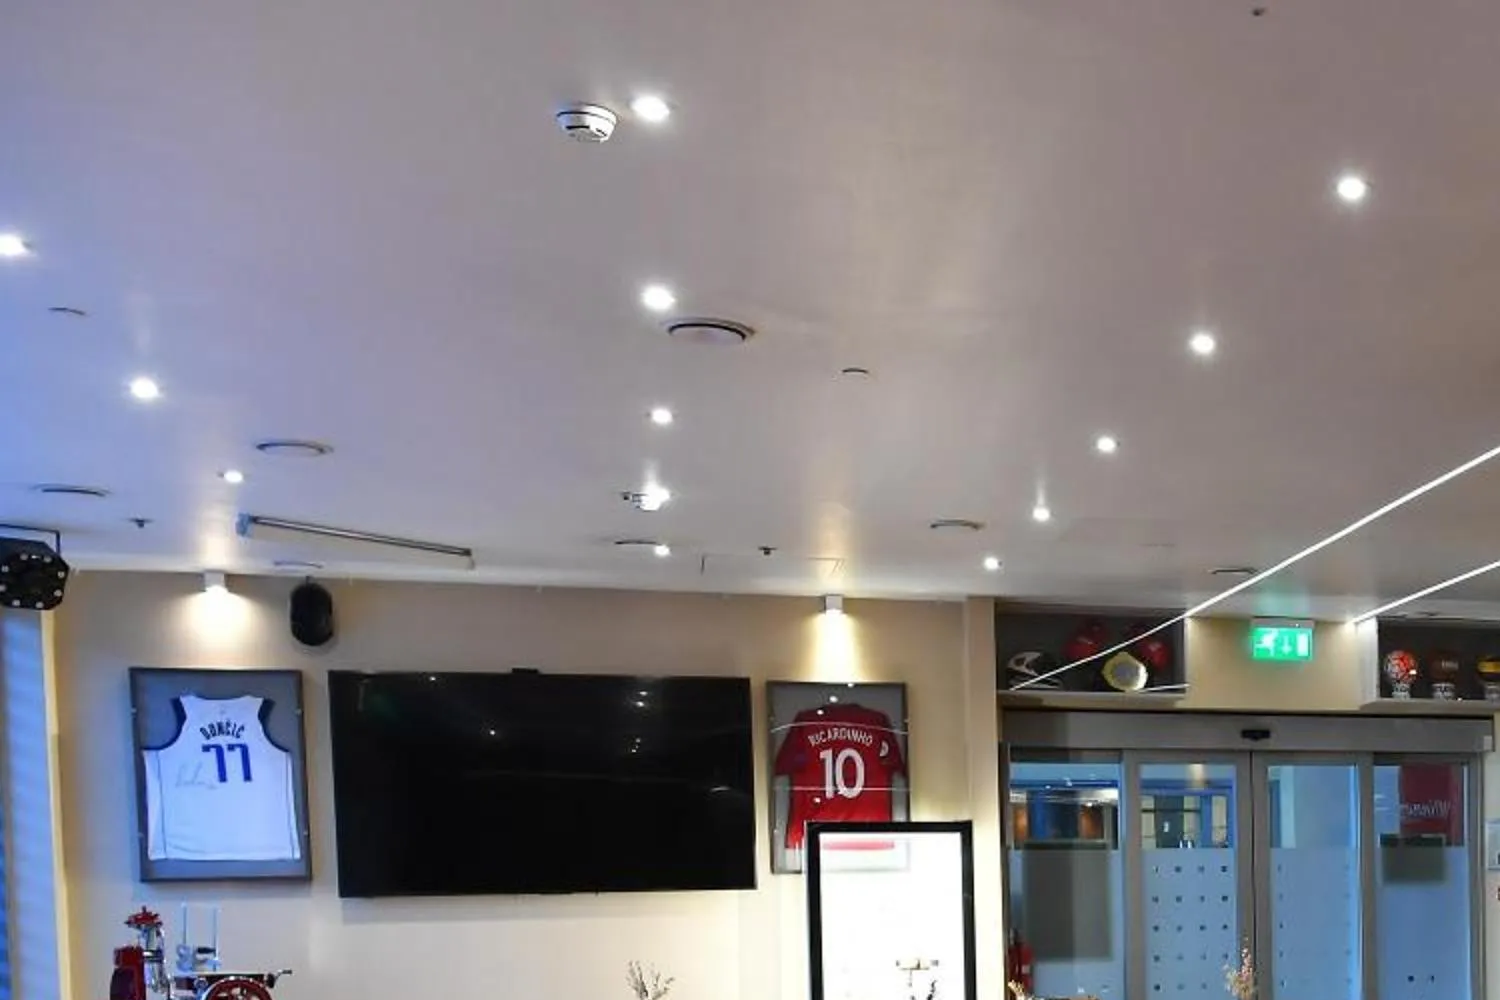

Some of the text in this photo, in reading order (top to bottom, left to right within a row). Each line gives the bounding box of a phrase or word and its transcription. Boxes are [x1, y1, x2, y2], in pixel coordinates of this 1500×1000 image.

[808, 727, 873, 746] RICARDINHO
[202, 743, 252, 782] 77
[819, 748, 865, 799] 10
